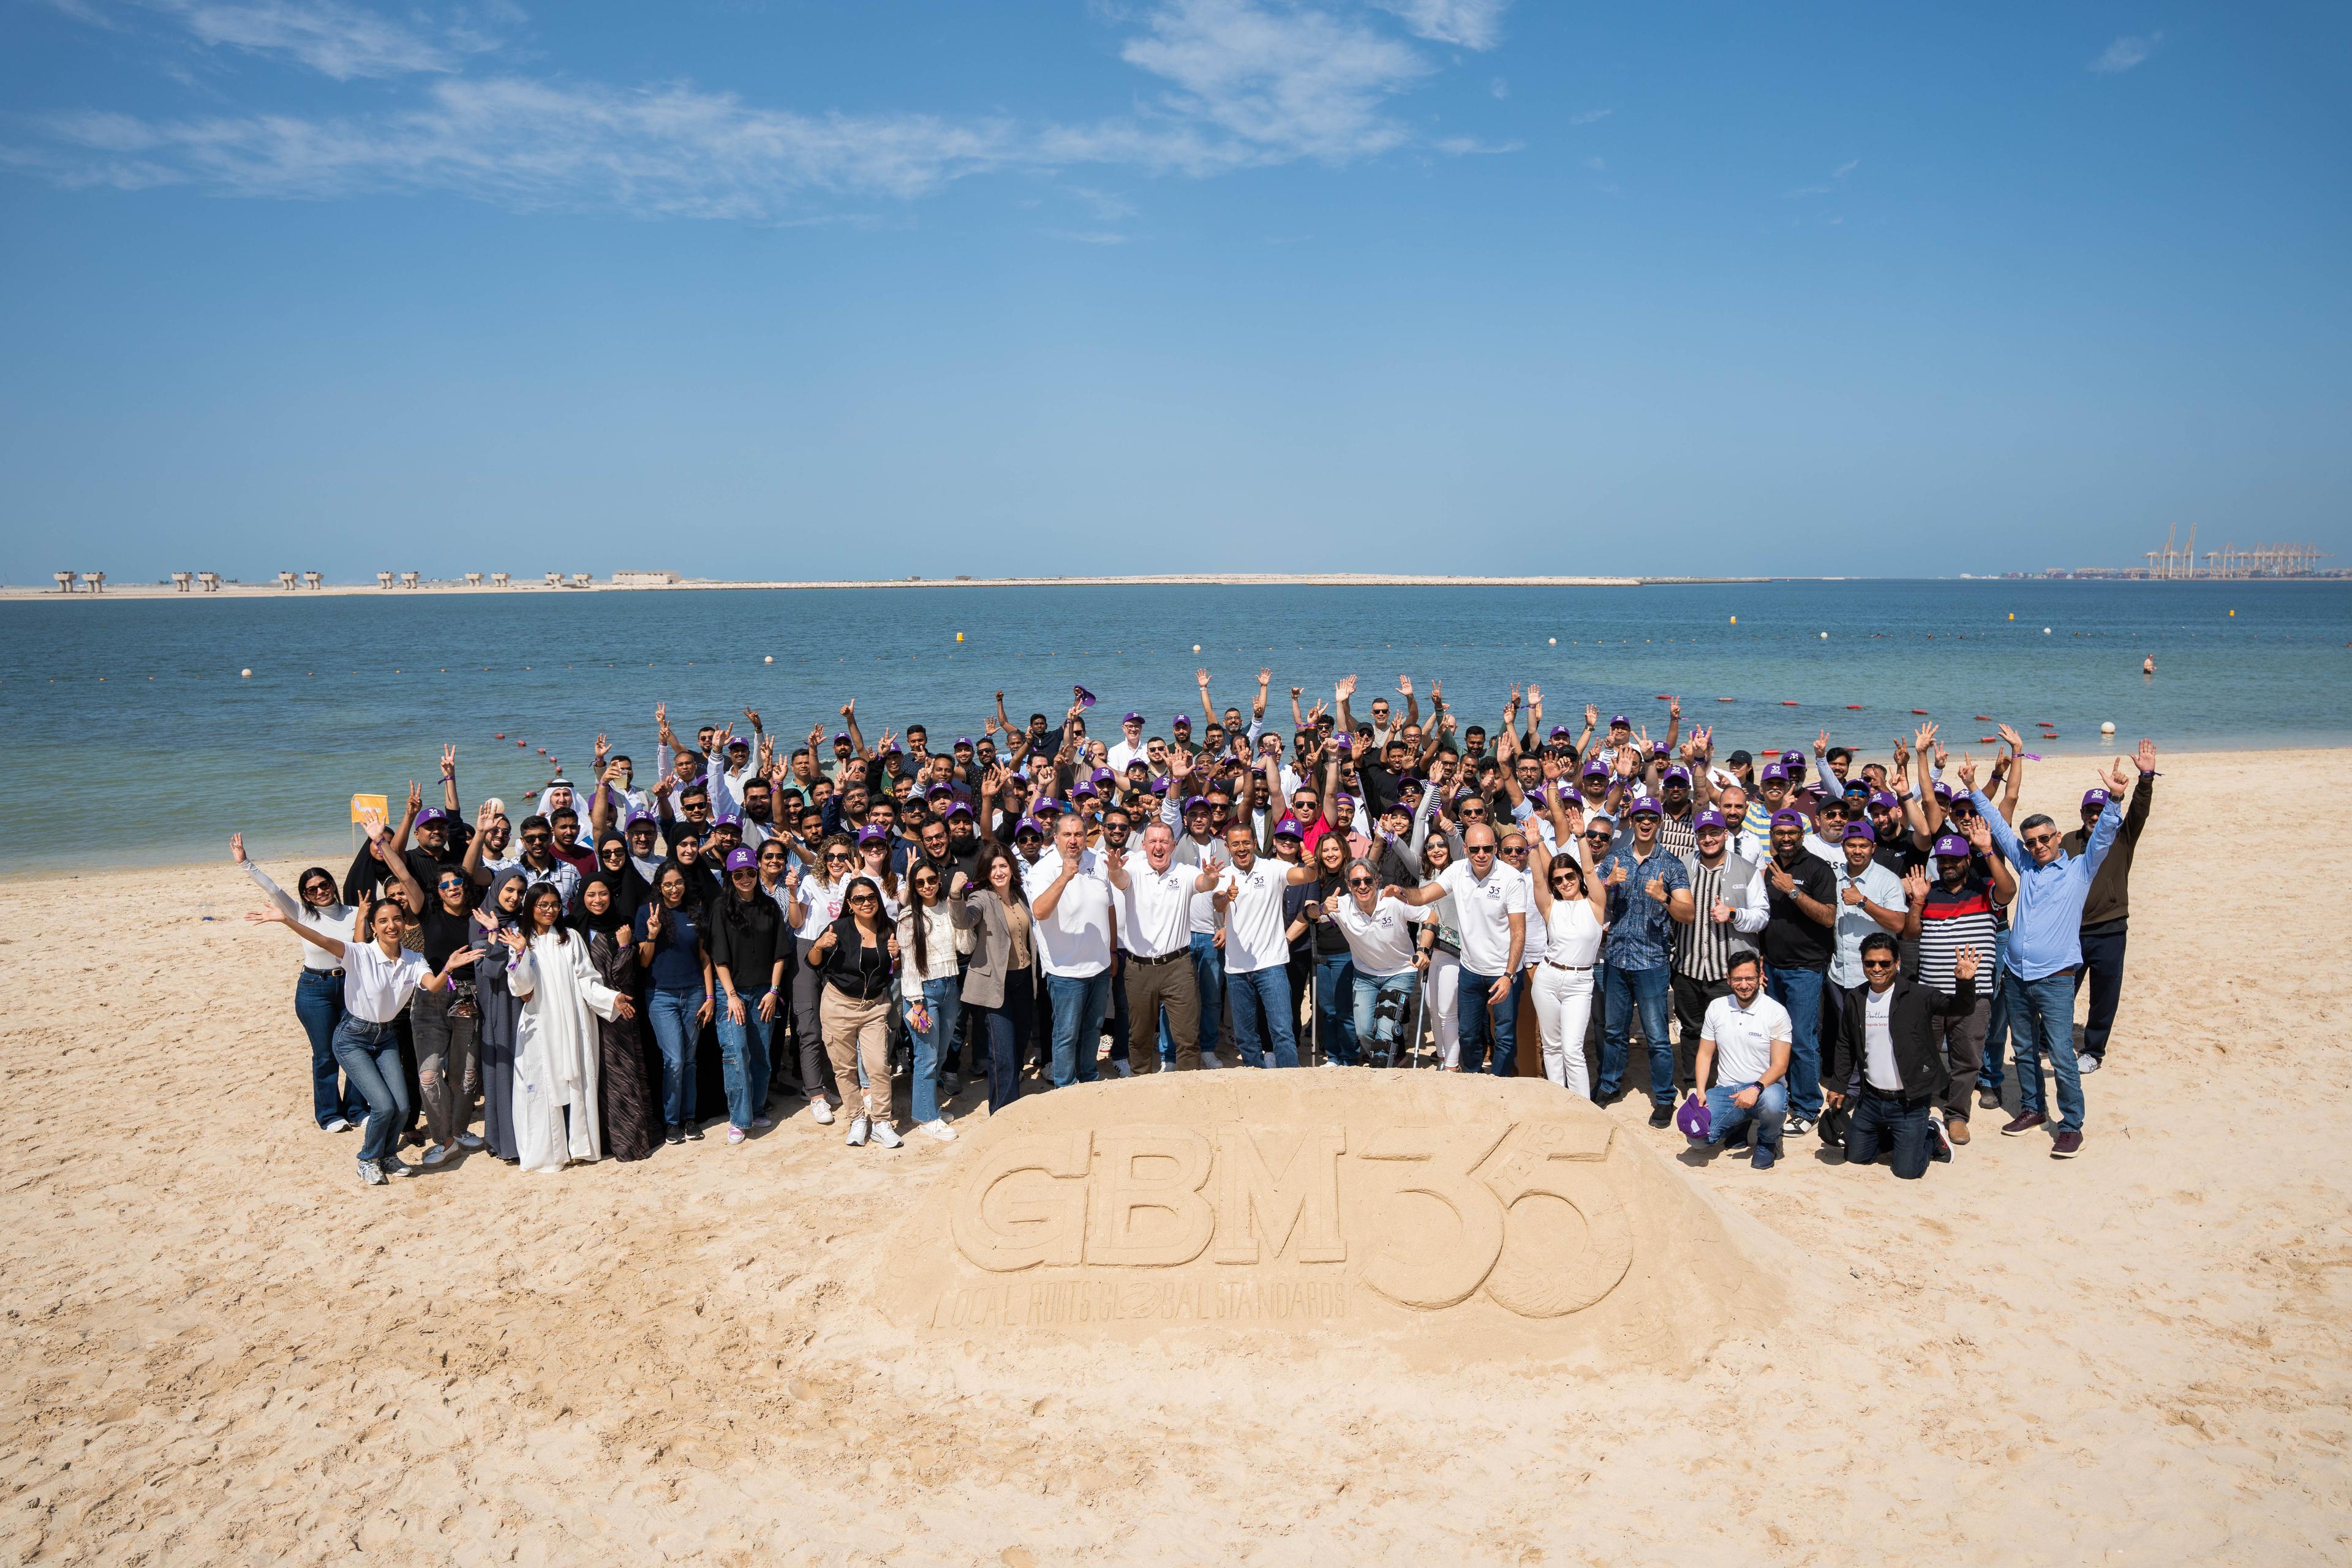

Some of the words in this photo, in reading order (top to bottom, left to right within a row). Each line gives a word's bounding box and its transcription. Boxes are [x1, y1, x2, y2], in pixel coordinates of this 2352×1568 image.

[951, 1125, 1348, 1273] GBM
[1356, 1121, 1634, 1319] 35
[926, 1284, 1019, 1329] LOCAL
[1215, 1281, 1346, 1319] STANDARDS
